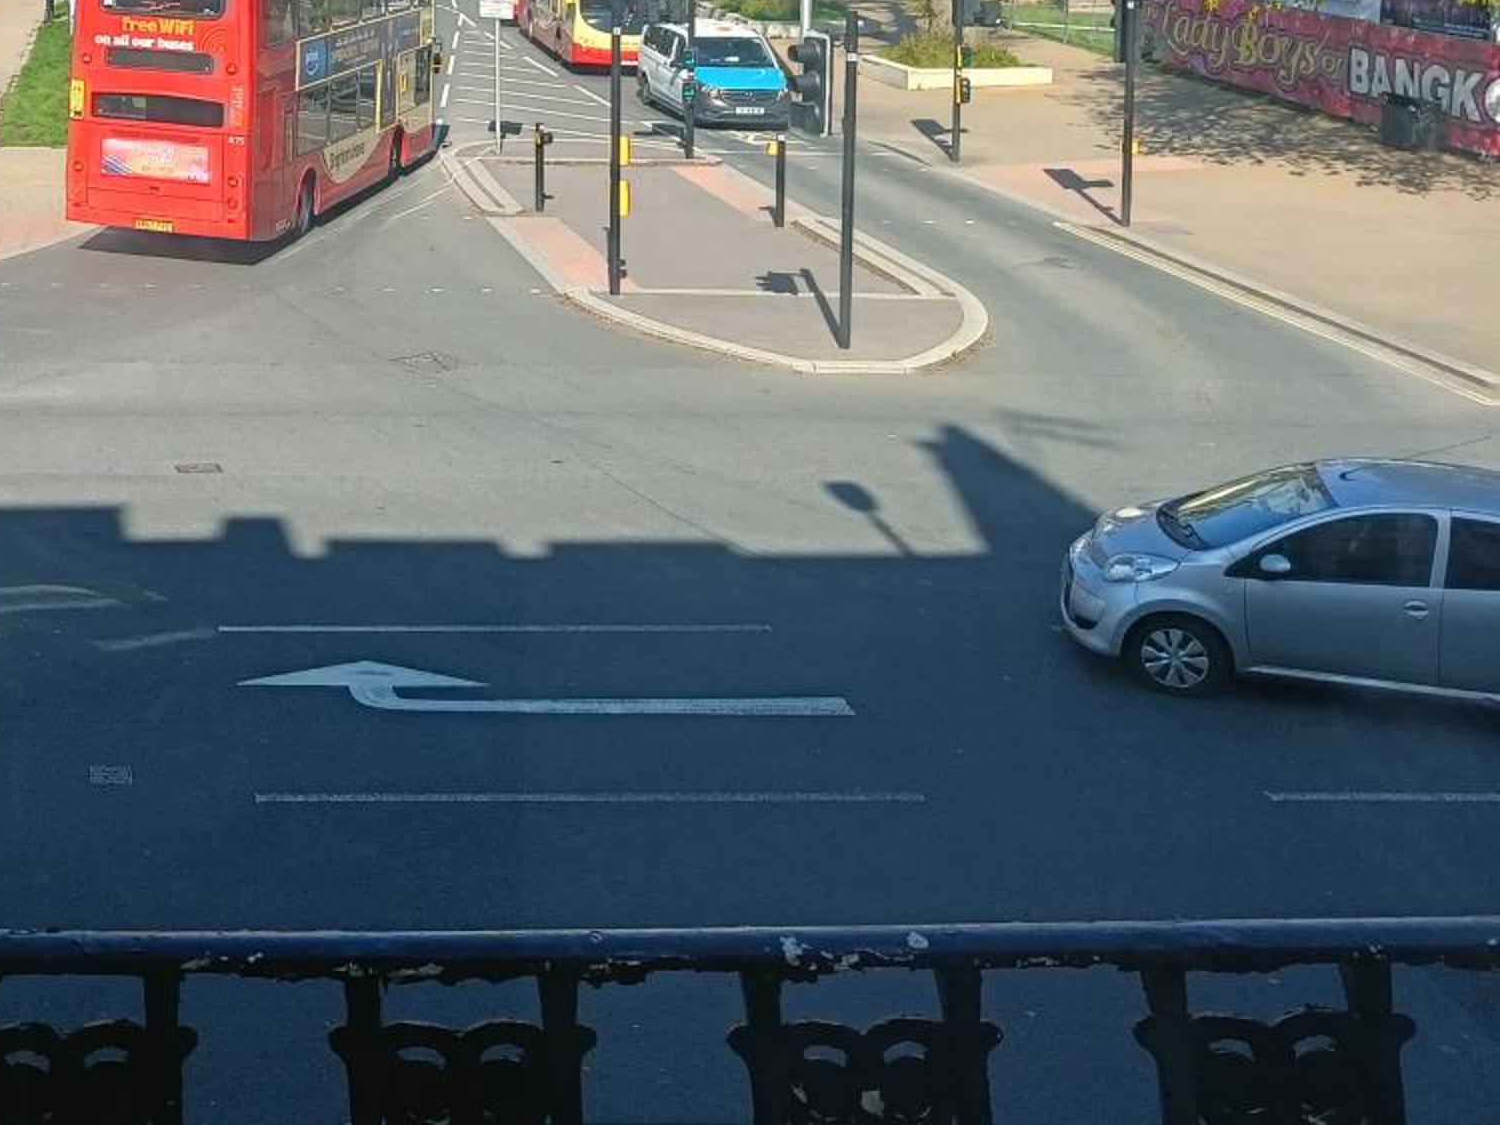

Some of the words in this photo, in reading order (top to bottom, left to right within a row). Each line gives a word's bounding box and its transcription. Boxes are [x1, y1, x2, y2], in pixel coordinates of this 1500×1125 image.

[94, 35, 111, 45] on
[113, 34, 130, 46] all
[132, 38, 154, 48] our
[157, 38, 195, 51] buses
